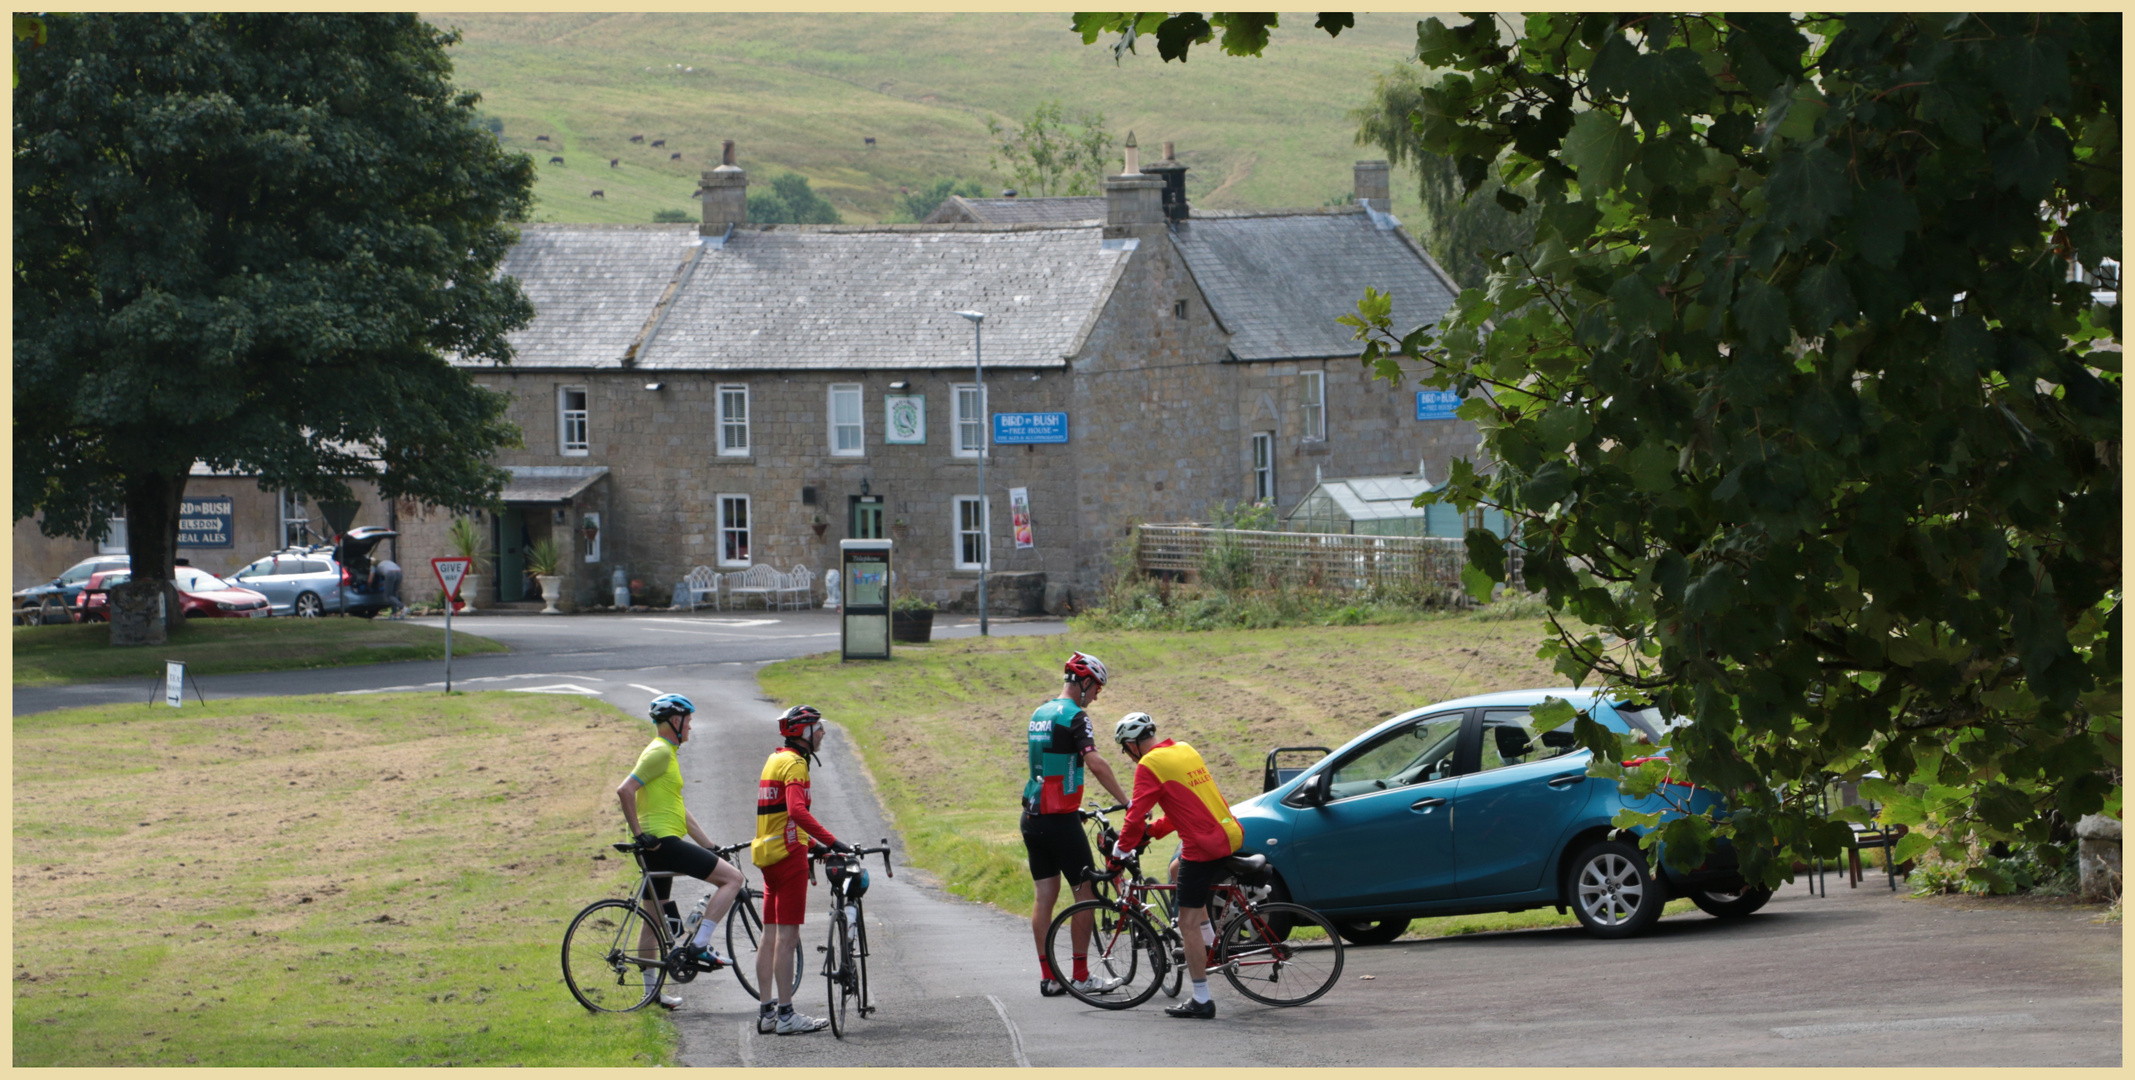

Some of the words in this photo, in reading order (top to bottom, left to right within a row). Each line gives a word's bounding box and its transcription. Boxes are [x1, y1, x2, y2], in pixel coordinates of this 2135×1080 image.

[1001, 415, 1024, 426] BIRD
[1033, 414, 1059, 426] BUSH
[180, 503, 194, 515] RD
[202, 502, 231, 515] BUSH
[202, 533, 227, 542] ALES
[440, 563, 461, 573] GIVE
[1029, 720, 1052, 732] BORA
[1187, 767, 1206, 778] TYNE
